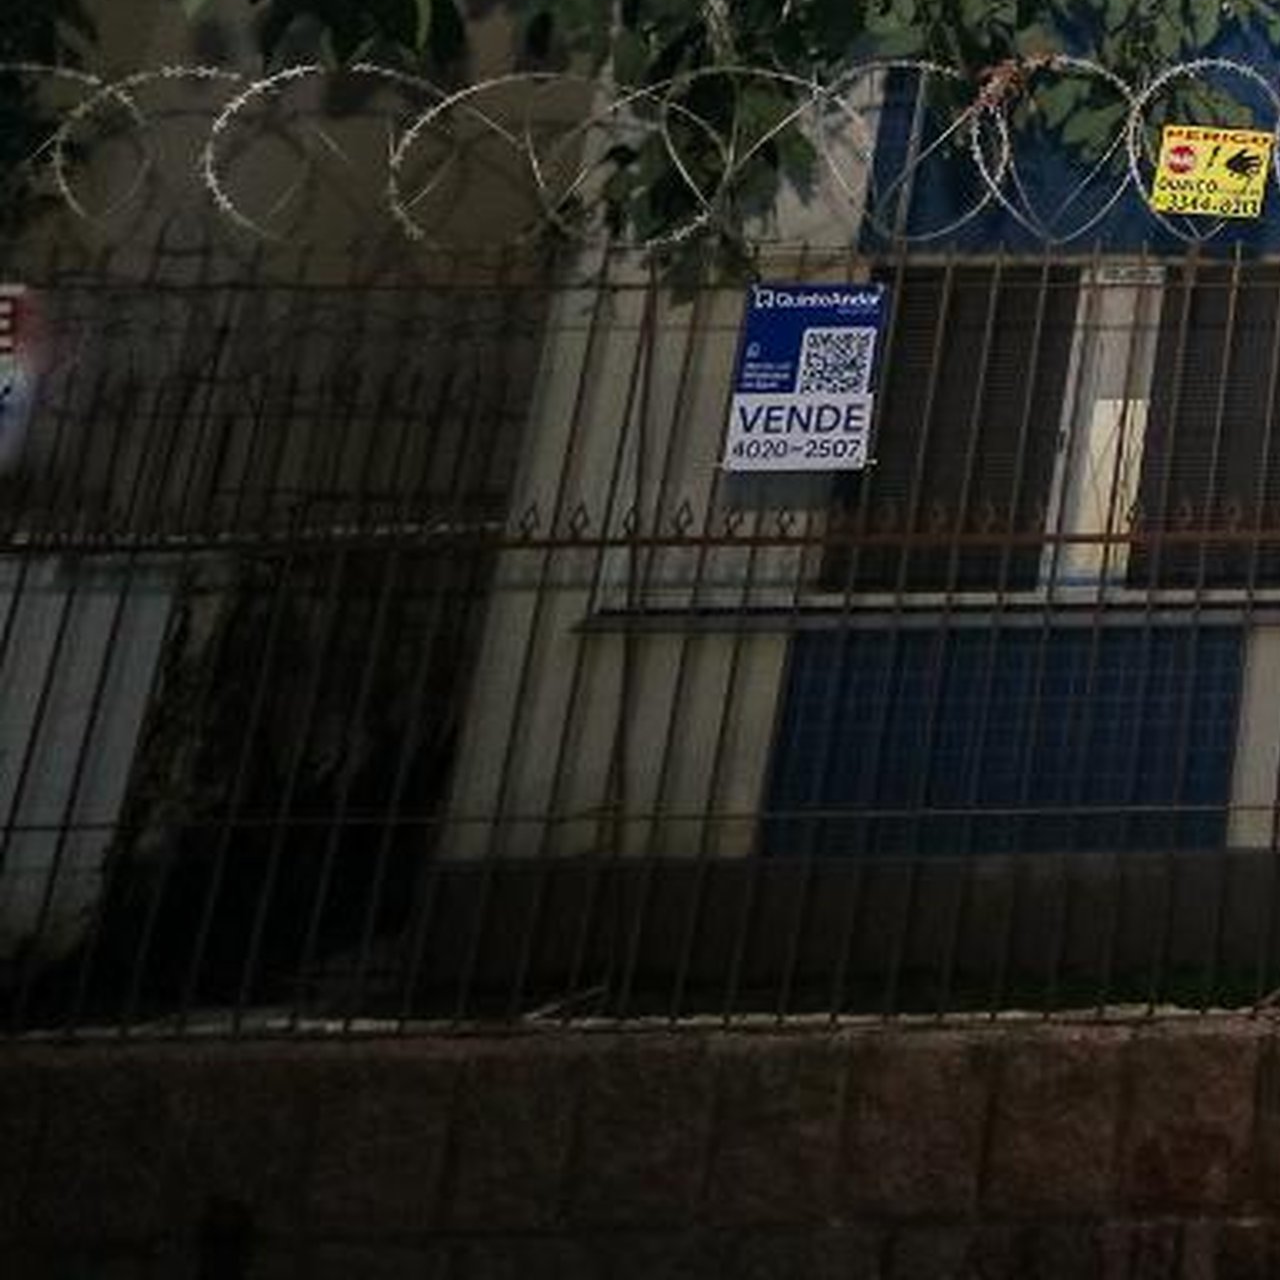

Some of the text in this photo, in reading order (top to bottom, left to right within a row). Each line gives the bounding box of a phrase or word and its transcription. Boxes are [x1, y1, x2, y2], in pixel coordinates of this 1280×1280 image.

[1167, 129, 1269, 145] PERIGO
[739, 404, 865, 434] VENDE
[732, 439, 862, 459] 4020-2507
